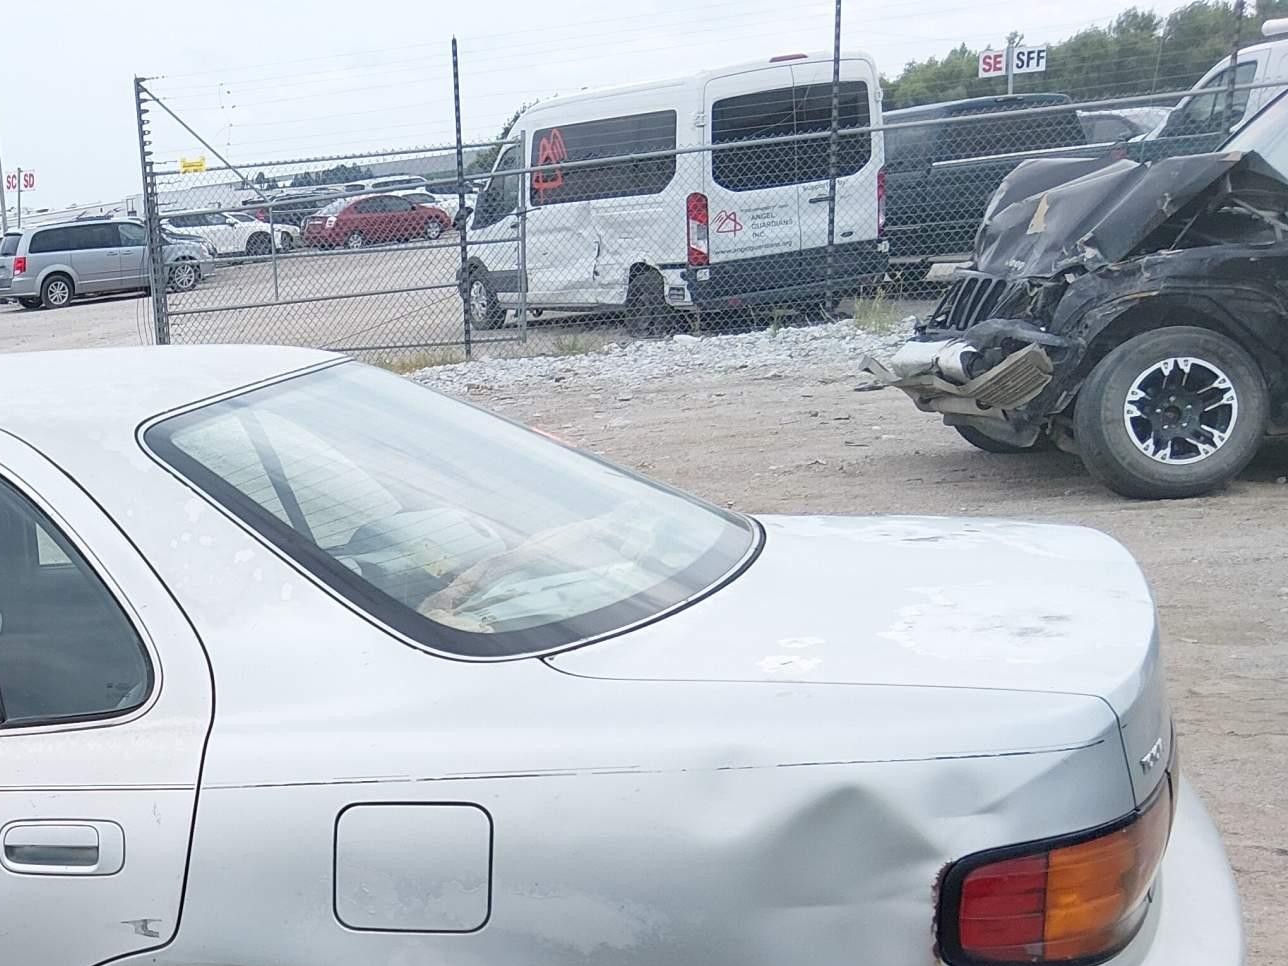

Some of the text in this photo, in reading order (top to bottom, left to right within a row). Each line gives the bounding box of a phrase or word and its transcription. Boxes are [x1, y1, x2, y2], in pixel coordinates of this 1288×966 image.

[982, 54, 1003, 72] SE
[1015, 49, 1046, 69] SFF
[6, 174, 17, 190] SC
[23, 173, 35, 189] SD
[751, 212, 776, 220] ANGEL
